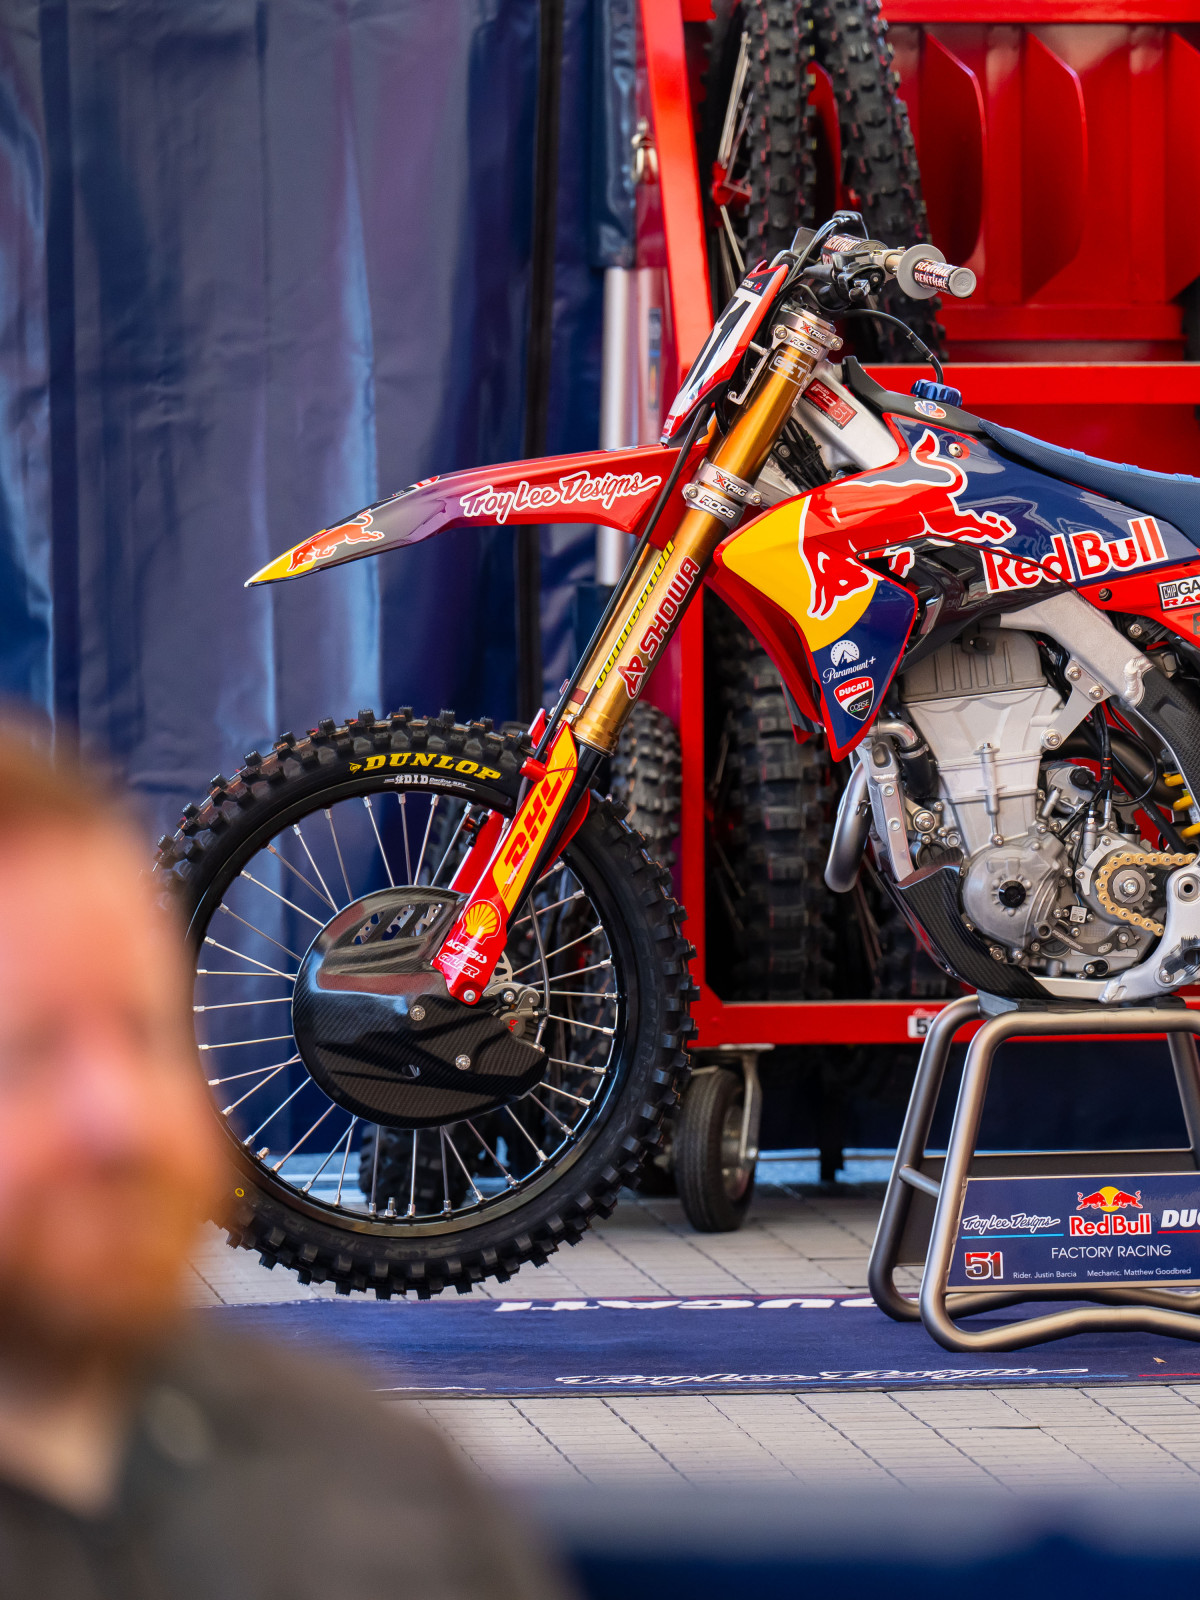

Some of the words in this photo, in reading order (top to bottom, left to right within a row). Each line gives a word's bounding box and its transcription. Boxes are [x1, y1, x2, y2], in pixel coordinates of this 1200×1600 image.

[800, 321, 827, 340] XTRIG
[790, 337, 819, 355] ROCS
[774, 356, 806, 378] GET
[713, 470, 748, 497] XTRIG
[460, 485, 511, 524] Troy
[511, 481, 559, 511] Lee
[559, 470, 661, 510] Designs
[699, 495, 736, 518] ROCS
[980, 534, 1076, 593] Red
[1069, 516, 1168, 580] Bull
[639, 556, 700, 660] SHOWA
[839, 680, 869, 696] DUCATI
[850, 699, 869, 711] CORSE
[363, 752, 501, 781] DUNLOP
[503, 776, 565, 876] DHL
[962, 1215, 989, 1235] Troy
[989, 1215, 1010, 1230] Lee
[1010, 1213, 1061, 1233] Designs
[1069, 1214, 1111, 1237] Red
[1112, 1213, 1152, 1236] Bull
[1051, 1246, 1114, 1259] FACTORY
[1117, 1245, 1172, 1258] RACING
[964, 1251, 1004, 1280] 51
[1056, 1270, 1077, 1278] Barcia
[1123, 1268, 1154, 1276] Matthew
[1155, 1267, 1191, 1275] Goodbred
